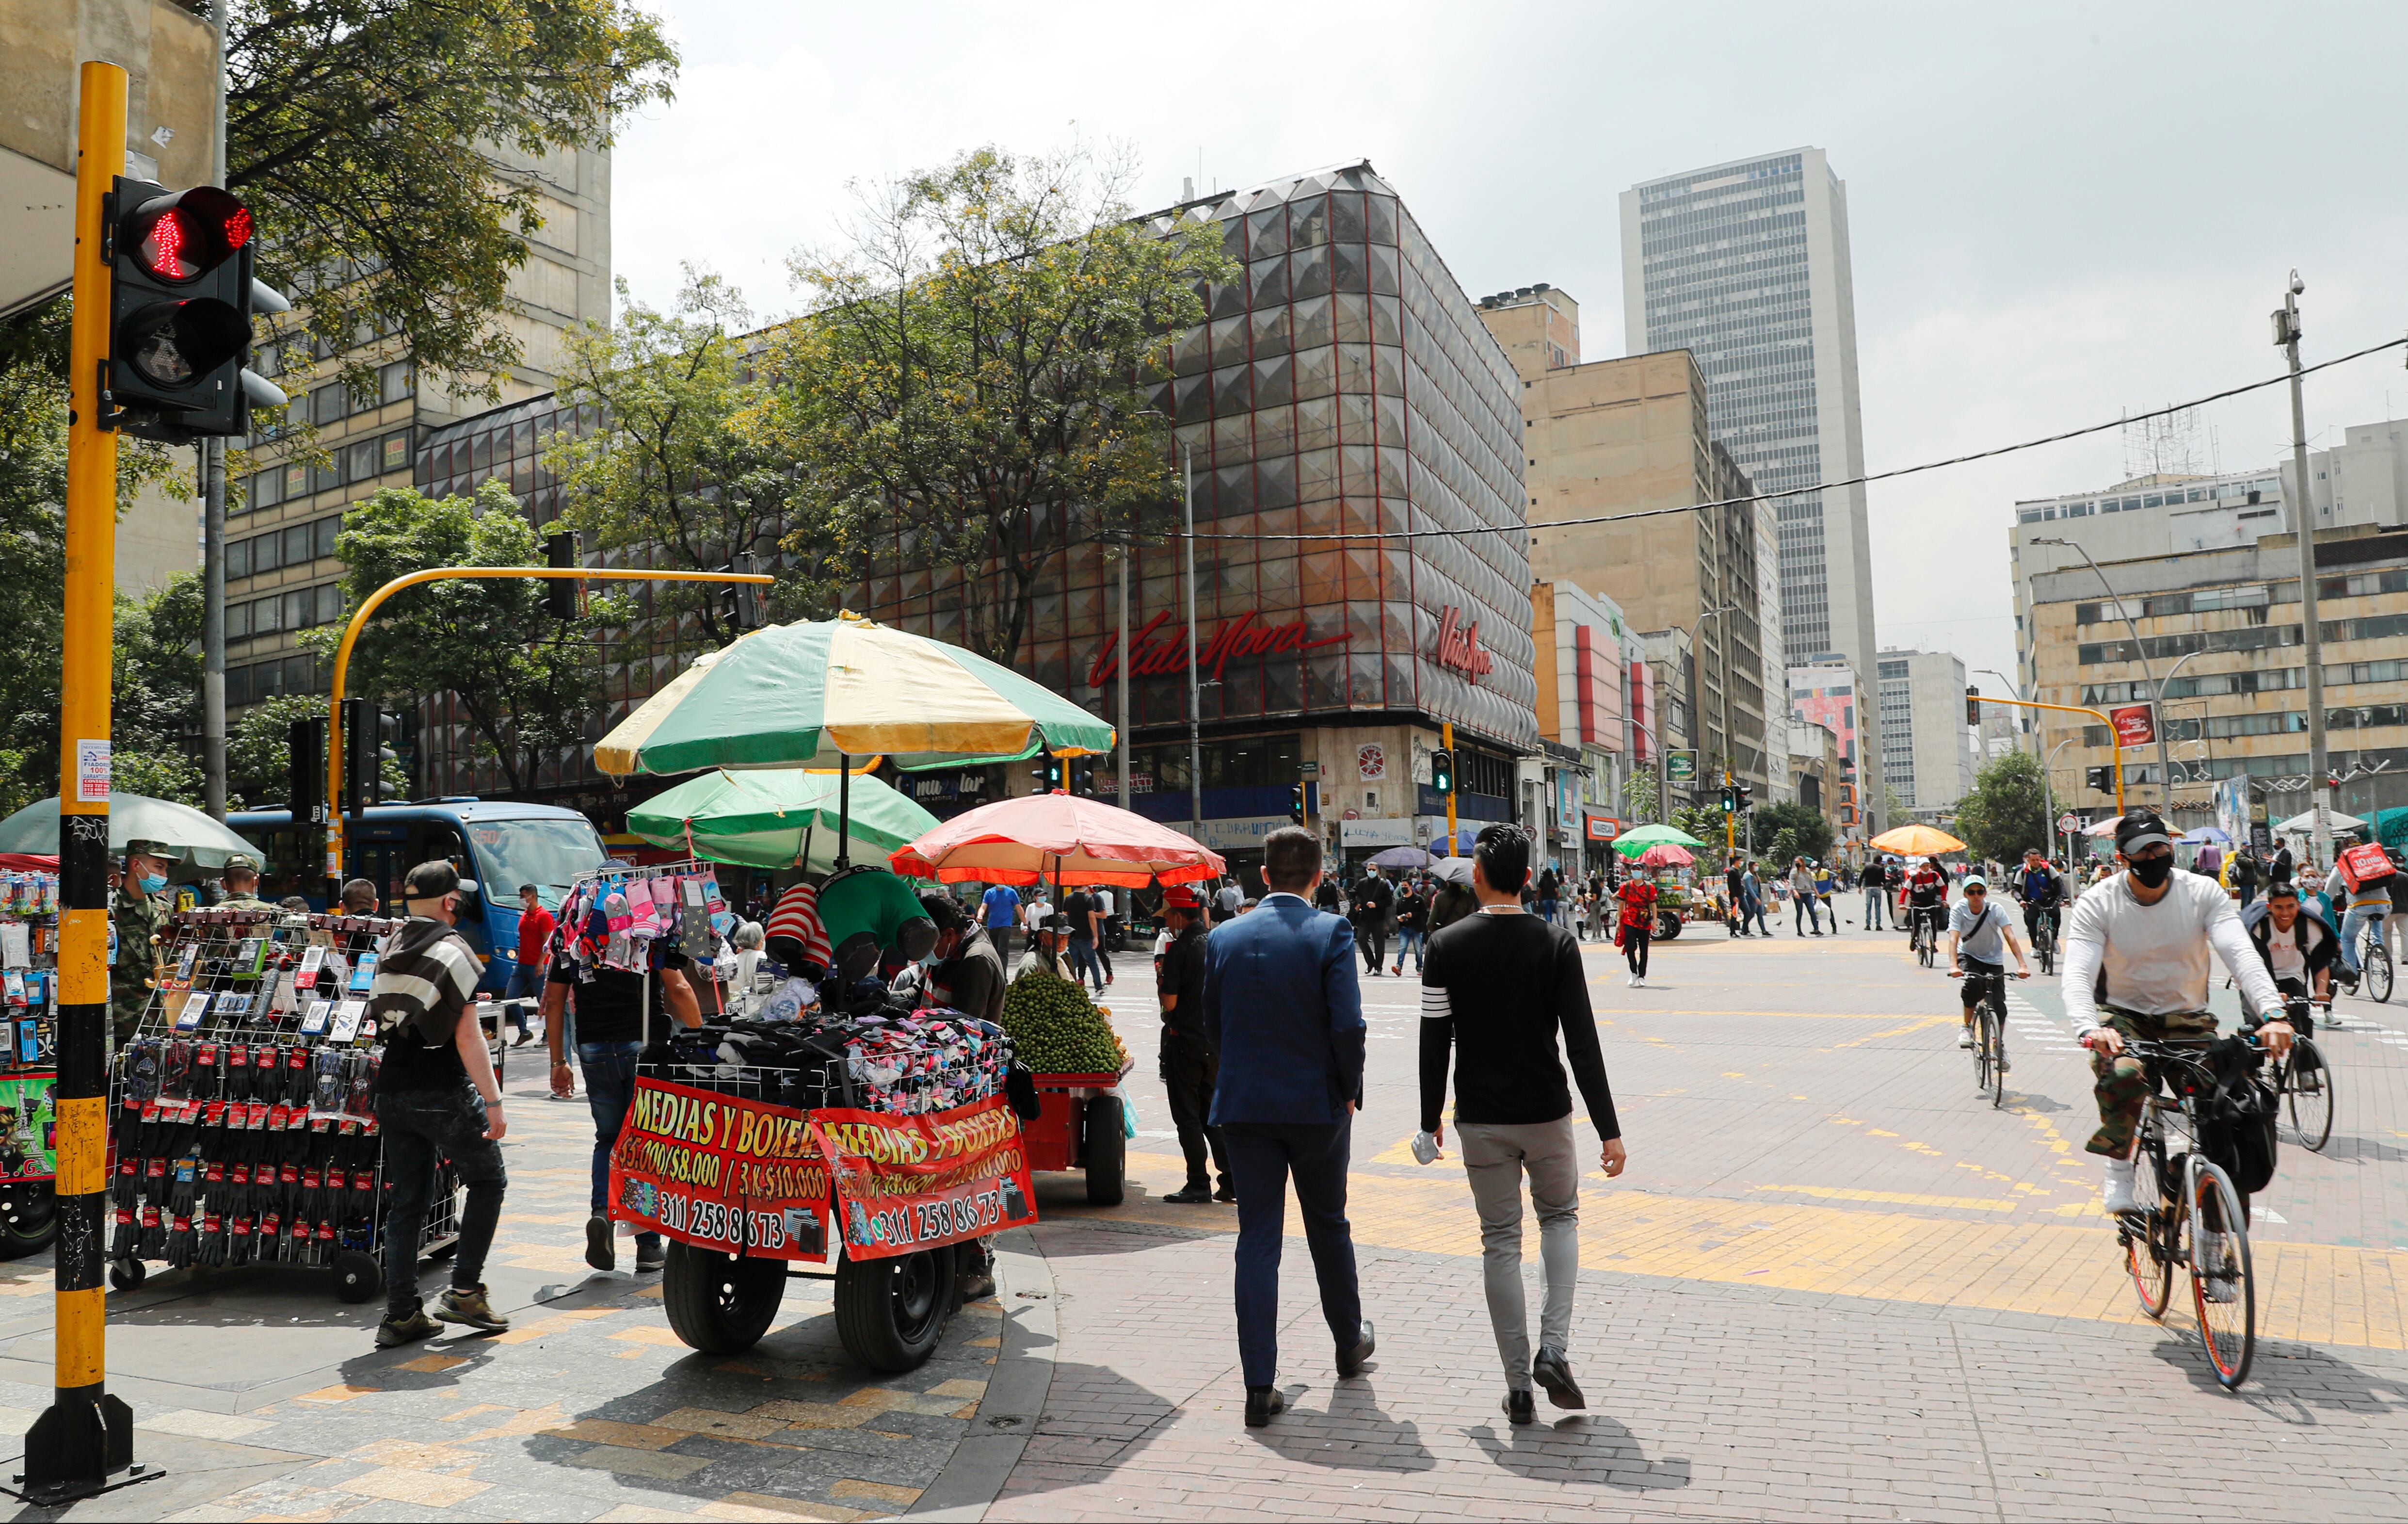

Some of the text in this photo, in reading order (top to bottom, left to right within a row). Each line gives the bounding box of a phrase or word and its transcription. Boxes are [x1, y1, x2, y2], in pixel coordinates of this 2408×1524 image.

[2354, 858, 2367, 867] 10
[631, 1086, 825, 1160] MEDIAS Y BOXER
[822, 1104, 1017, 1165] MEDIAS Y BOXERS
[738, 1161, 749, 1195] 3
[765, 1163, 827, 1201] $10.000
[660, 1191, 687, 1232] 311
[689, 1199, 727, 1241] 258
[758, 1213, 785, 1249] 73
[878, 1189, 1000, 1247] 311 258 86 73
